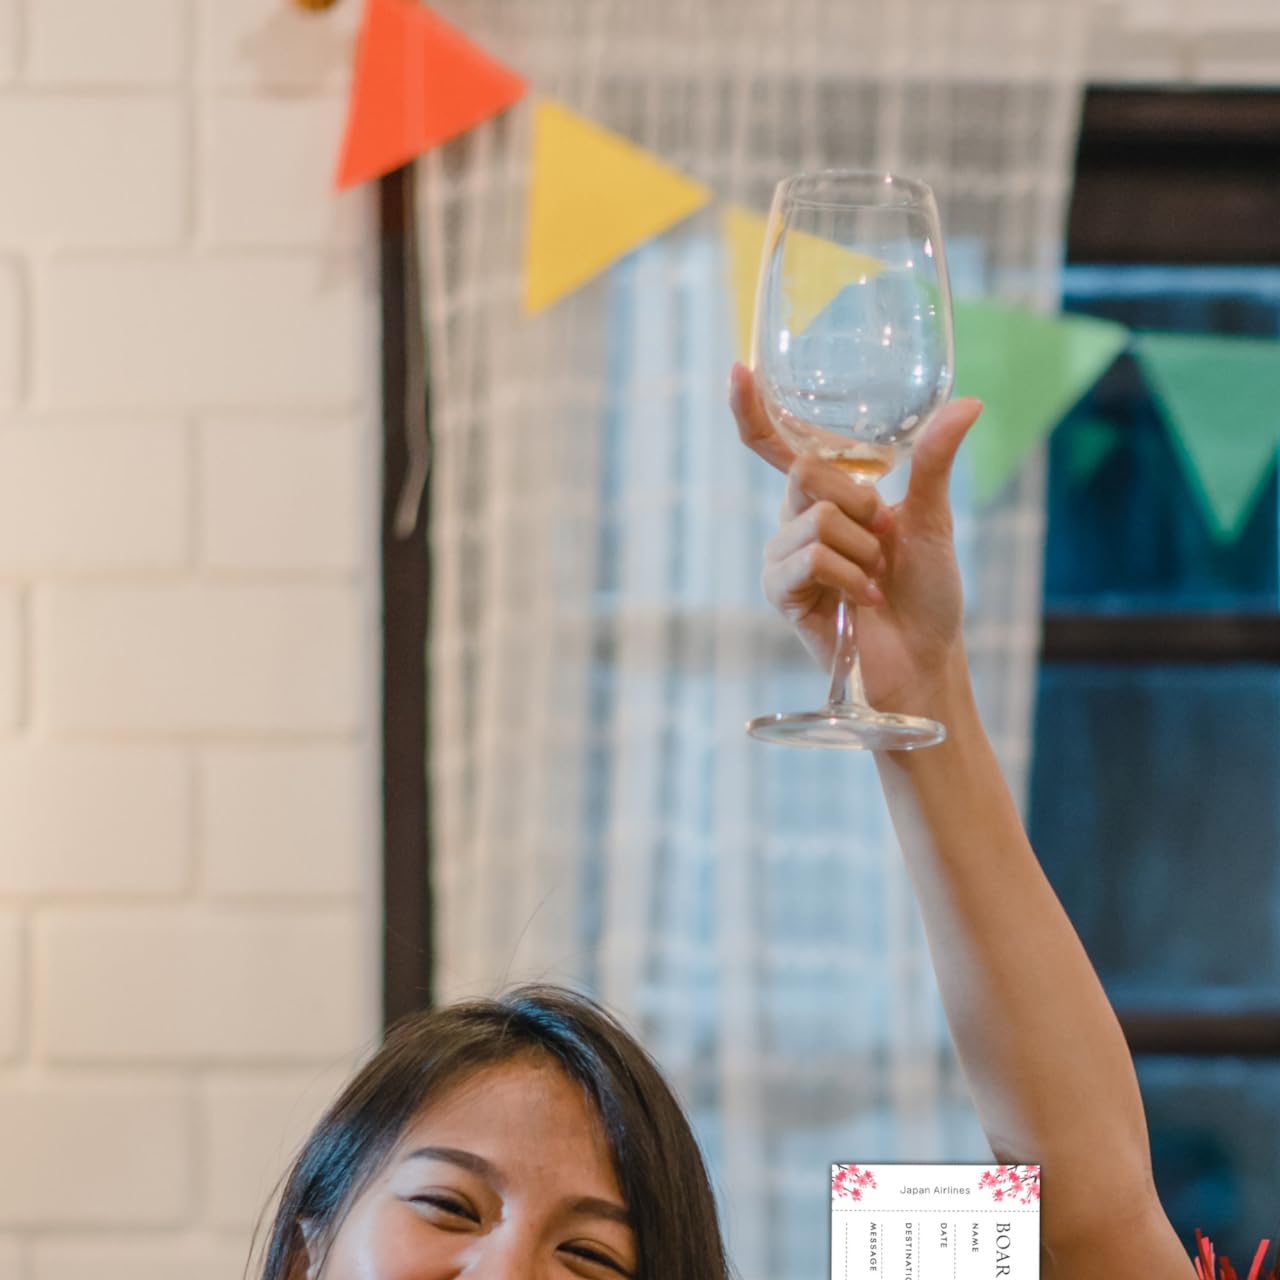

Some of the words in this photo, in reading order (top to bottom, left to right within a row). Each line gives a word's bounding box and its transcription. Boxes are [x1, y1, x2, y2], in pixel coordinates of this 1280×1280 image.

[899, 1186, 931, 1195] Japan
[933, 1186, 971, 1195] Airlines
[940, 1222, 948, 1249] DATE
